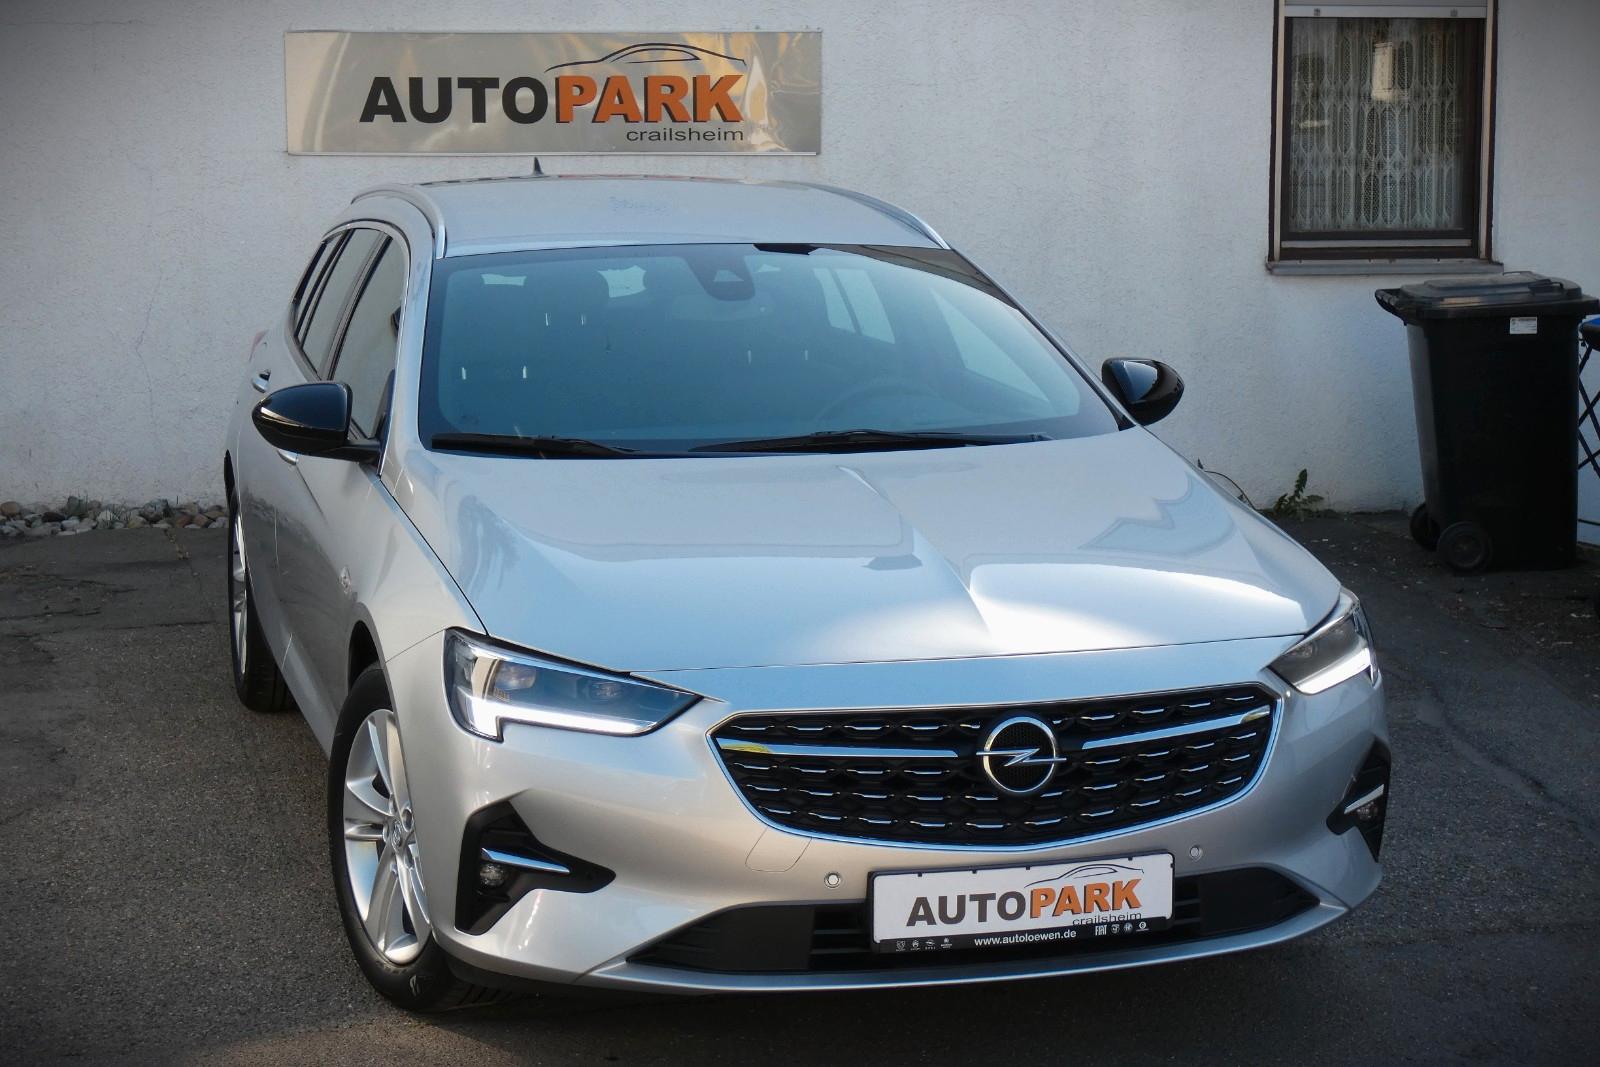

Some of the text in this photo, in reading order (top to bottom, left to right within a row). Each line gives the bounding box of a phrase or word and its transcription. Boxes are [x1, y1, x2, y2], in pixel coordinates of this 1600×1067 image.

[359, 74, 744, 124] AUTOPARK
[626, 128, 744, 141] crailsheim
[906, 878, 1142, 927] AUTOPARK
[1072, 912, 1142, 926] crailsheim
[974, 929, 1077, 947] www.autoloewen.de
[1095, 924, 1108, 936] FIAT
